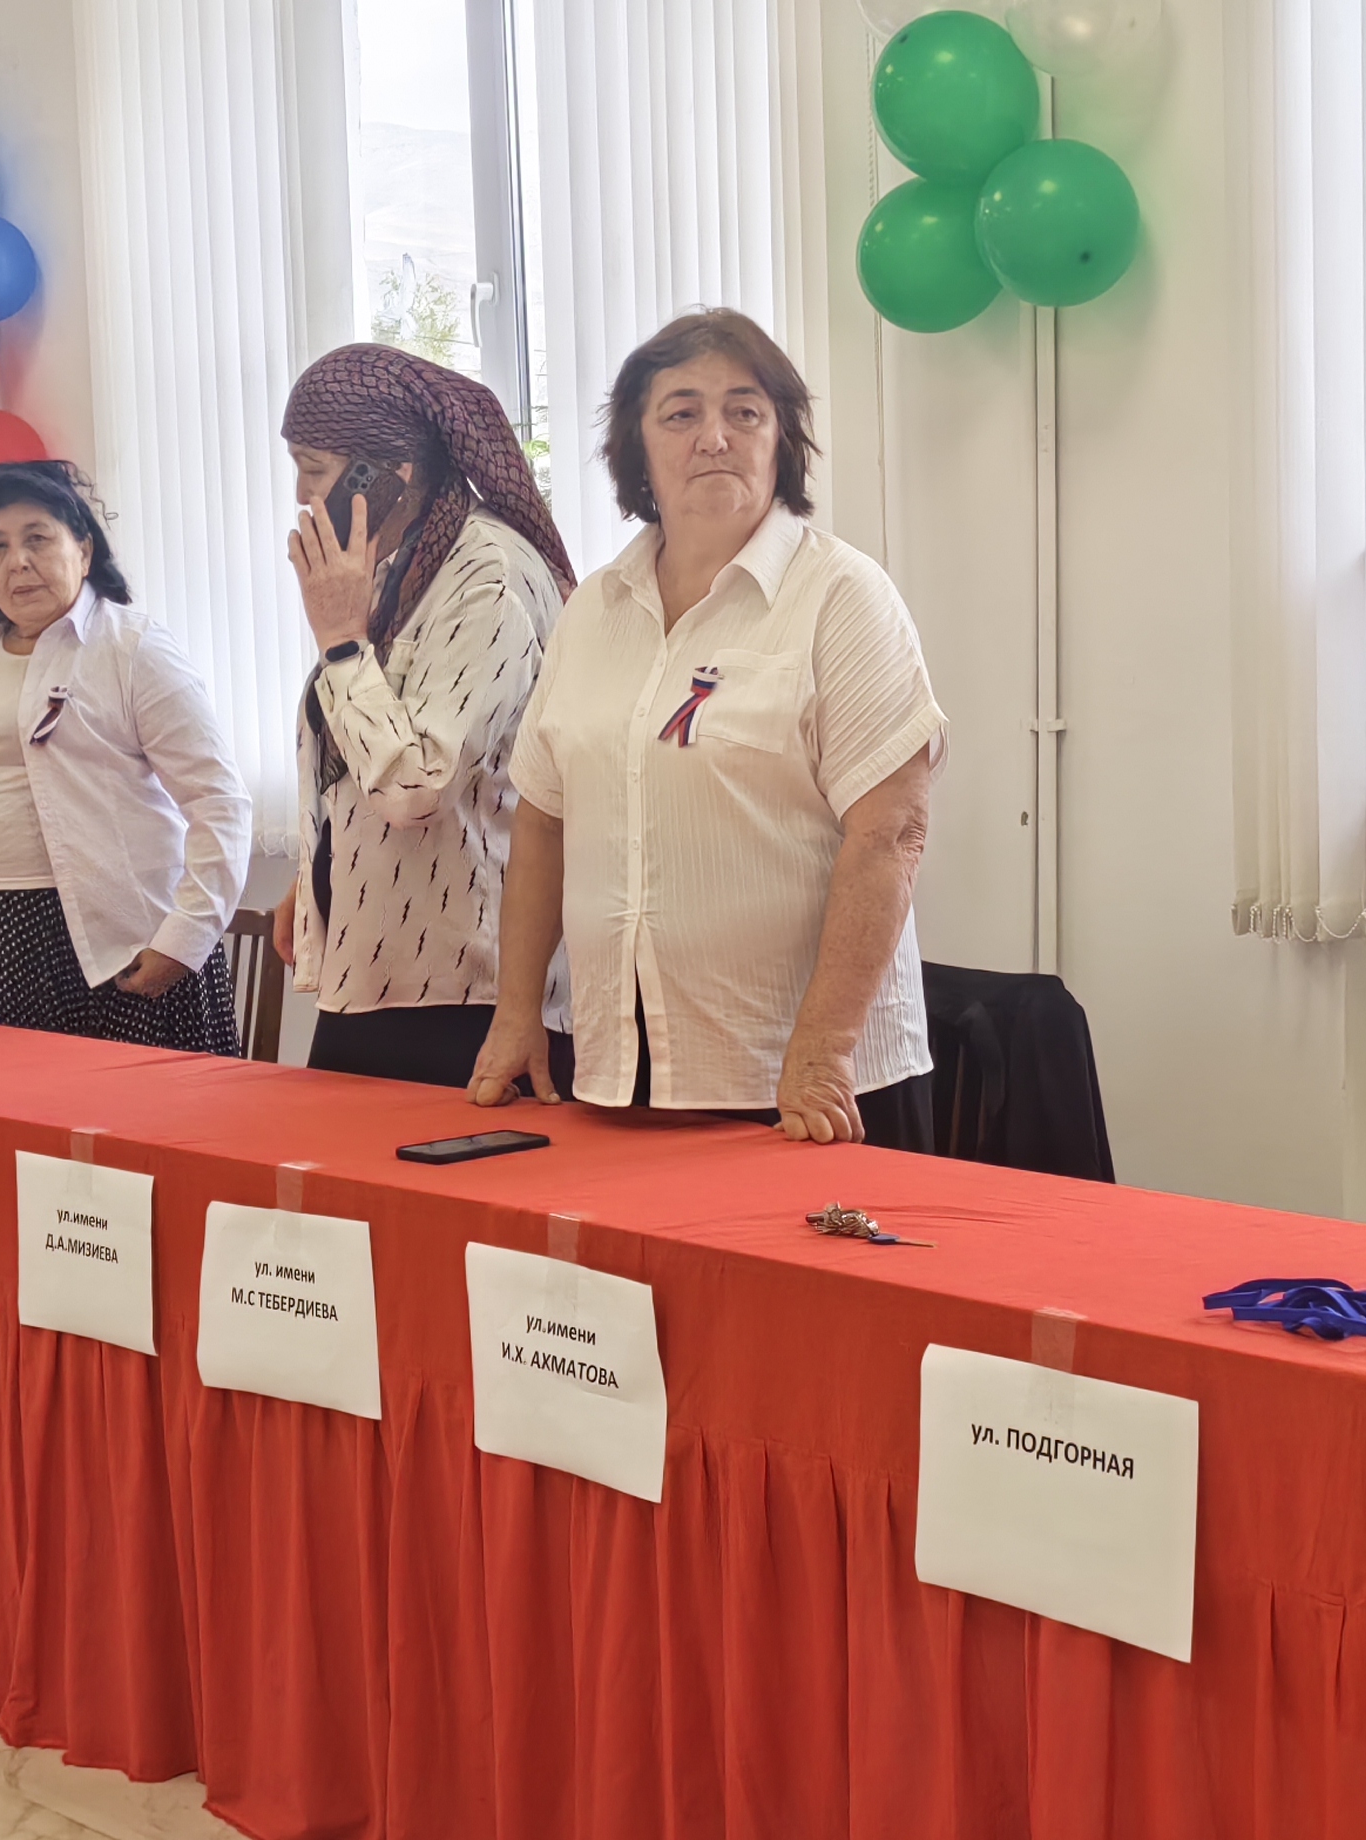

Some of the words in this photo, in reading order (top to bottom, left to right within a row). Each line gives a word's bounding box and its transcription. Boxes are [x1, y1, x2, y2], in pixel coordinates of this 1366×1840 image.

[56, 1209, 108, 1231] ул.имени
[45, 1233, 119, 1264] Д.А.МИЗИЕВА
[255, 1261, 272, 1278] ул.
[275, 1264, 316, 1284] имени
[231, 1286, 255, 1306] М.С
[258, 1291, 339, 1321] ТЕБЕРДИЕВА
[526, 1314, 596, 1346] ул.имени
[501, 1341, 527, 1366] И.Х.
[530, 1350, 619, 1389] АХМАТОВА
[971, 1423, 1000, 1445] ул.
[1006, 1427, 1134, 1480] ПОДГОРНАЯ
